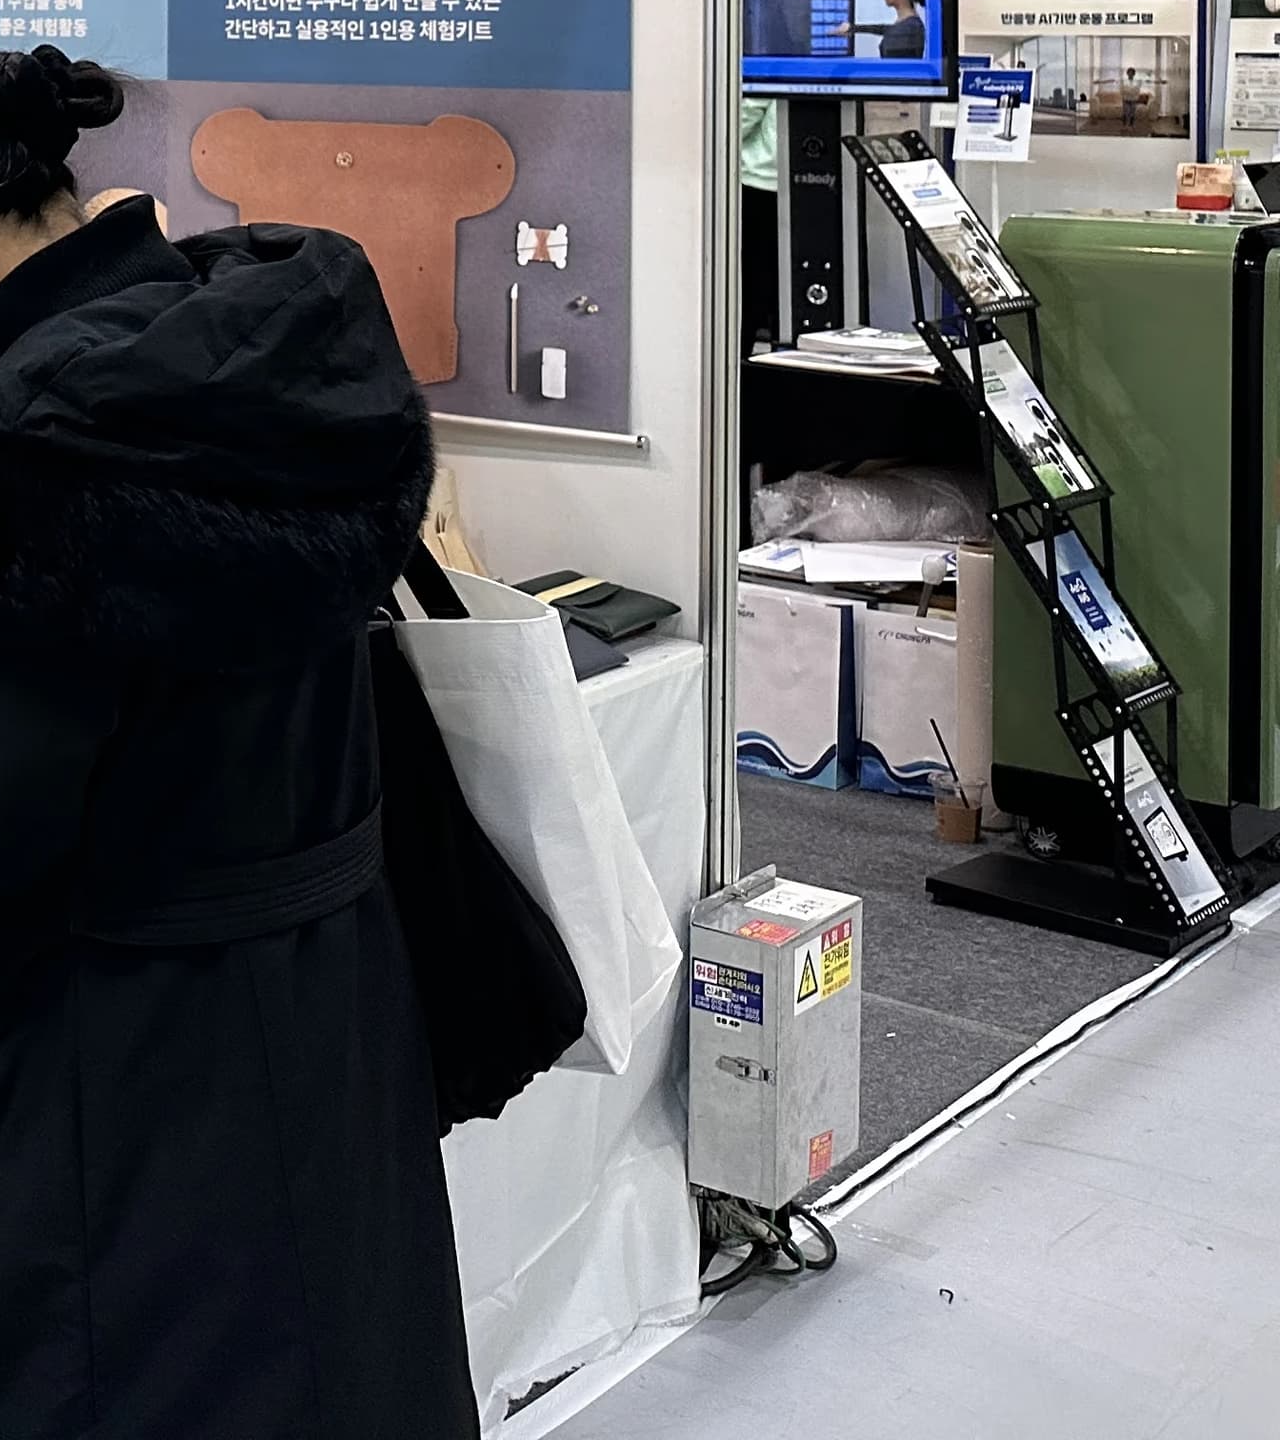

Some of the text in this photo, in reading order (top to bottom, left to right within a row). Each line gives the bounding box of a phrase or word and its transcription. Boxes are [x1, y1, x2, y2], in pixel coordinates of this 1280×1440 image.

[29, 18, 88, 38] 체험활동
[1039, 12, 1078, 25] AI기반
[224, 20, 493, 41] 간단하고 실용적인 1인용 체험키트
